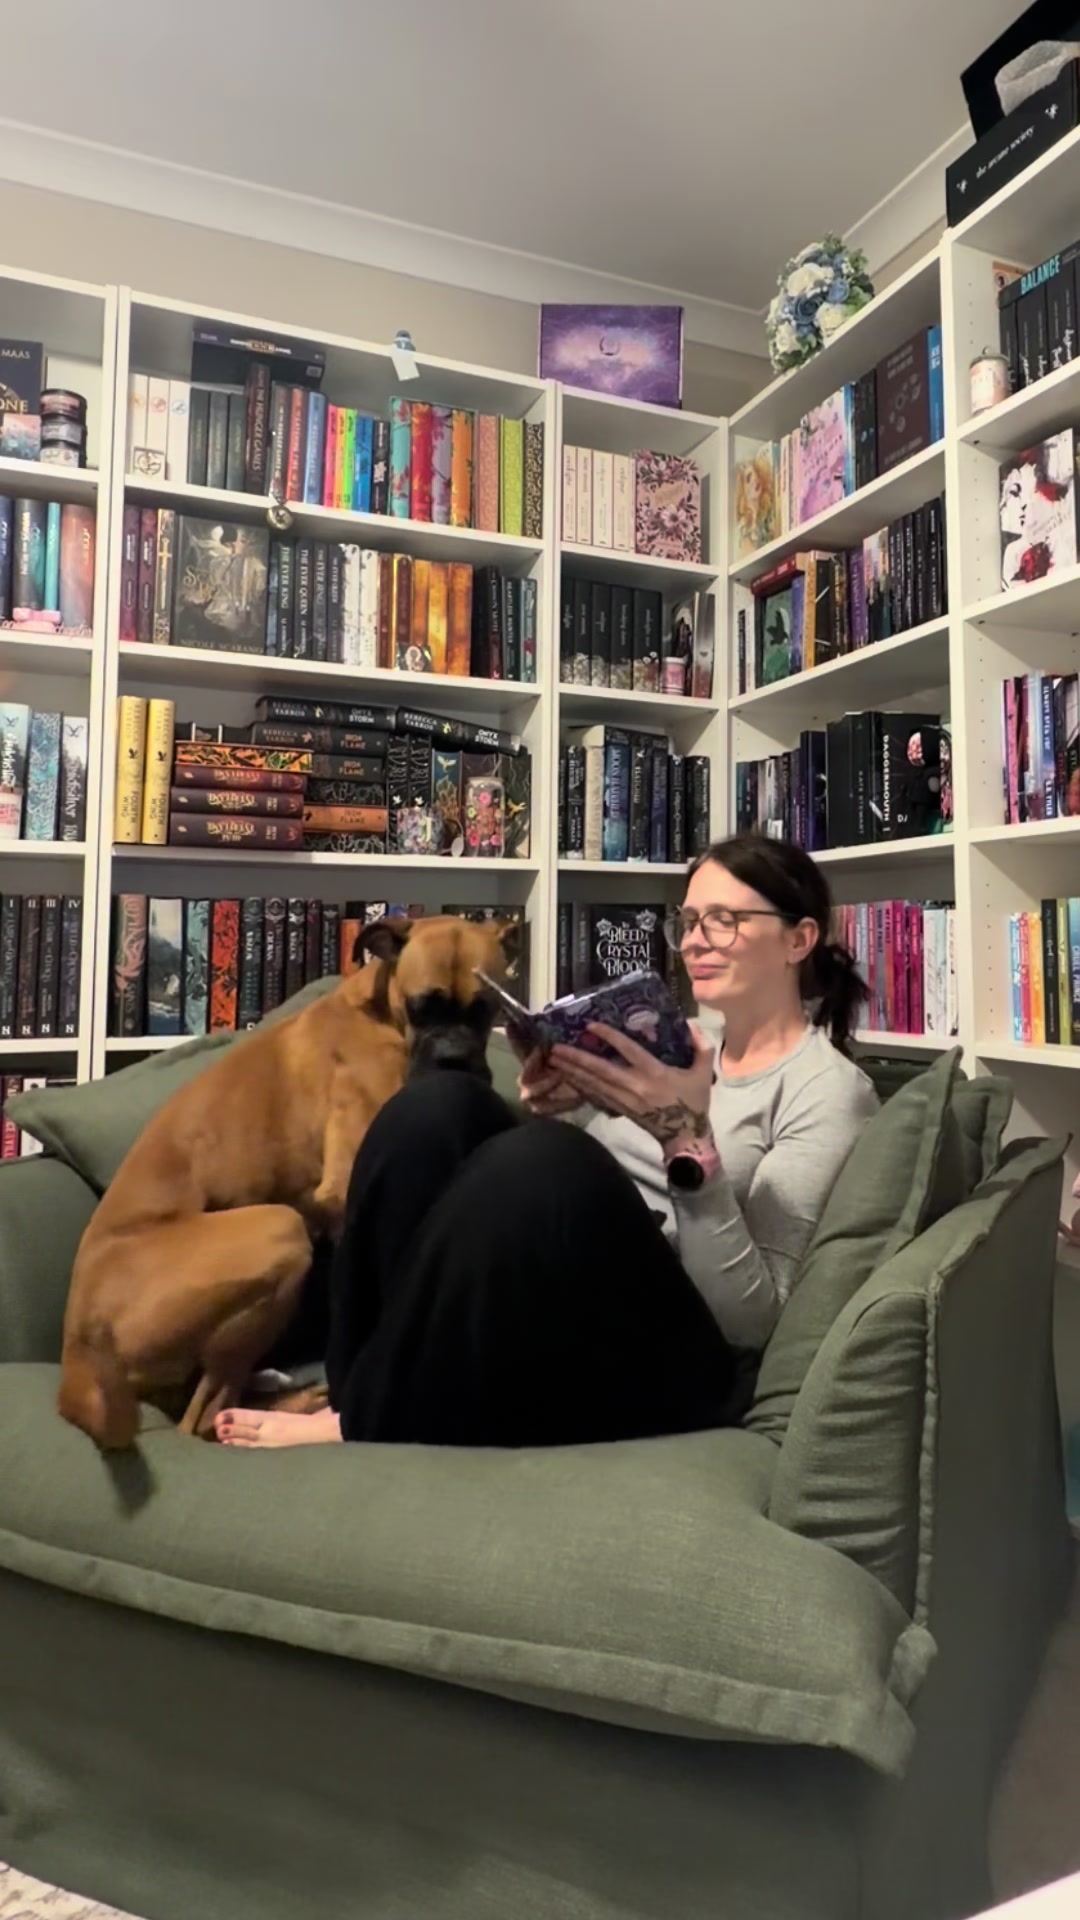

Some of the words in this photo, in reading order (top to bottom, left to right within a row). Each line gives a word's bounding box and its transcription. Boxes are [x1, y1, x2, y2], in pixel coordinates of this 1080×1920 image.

[1020, 254, 1061, 296] BALANCE
[1, 349, 31, 360] MAAS
[253, 402, 265, 438] HUNGER
[252, 439, 263, 471] GAMES
[280, 547, 290, 563] THE
[300, 549, 309, 564] THE
[280, 564, 290, 585] EVER
[300, 565, 309, 586] EVER
[280, 586, 290, 609] KING
[299, 587, 309, 616] QUEEN
[348, 714, 375, 724] STORM
[404, 712, 438, 726] REBECCA
[405, 719, 434, 731] YARROS
[262, 728, 298, 738] REBECCA
[474, 734, 499, 747] STORM
[478, 728, 499, 740] ONYX
[340, 740, 367, 751] FLAME
[338, 767, 365, 776] FLAME
[882, 734, 891, 822] DAGGERMOUTH
[121, 796, 130, 818] WING
[130, 790, 139, 824] FOURTH
[149, 798, 157, 820] WING
[158, 793, 167, 826] FOURTH
[857, 795, 865, 835] STEWART
[339, 816, 366, 825] FLAME
[28, 899, 36, 909] II
[46, 899, 56, 909] III
[607, 926, 645, 944] BLEED
[596, 936, 651, 963] CRYSTAL
[1071, 944, 1080, 971] CRUEL
[1071, 973, 1080, 1004] PRINCE
